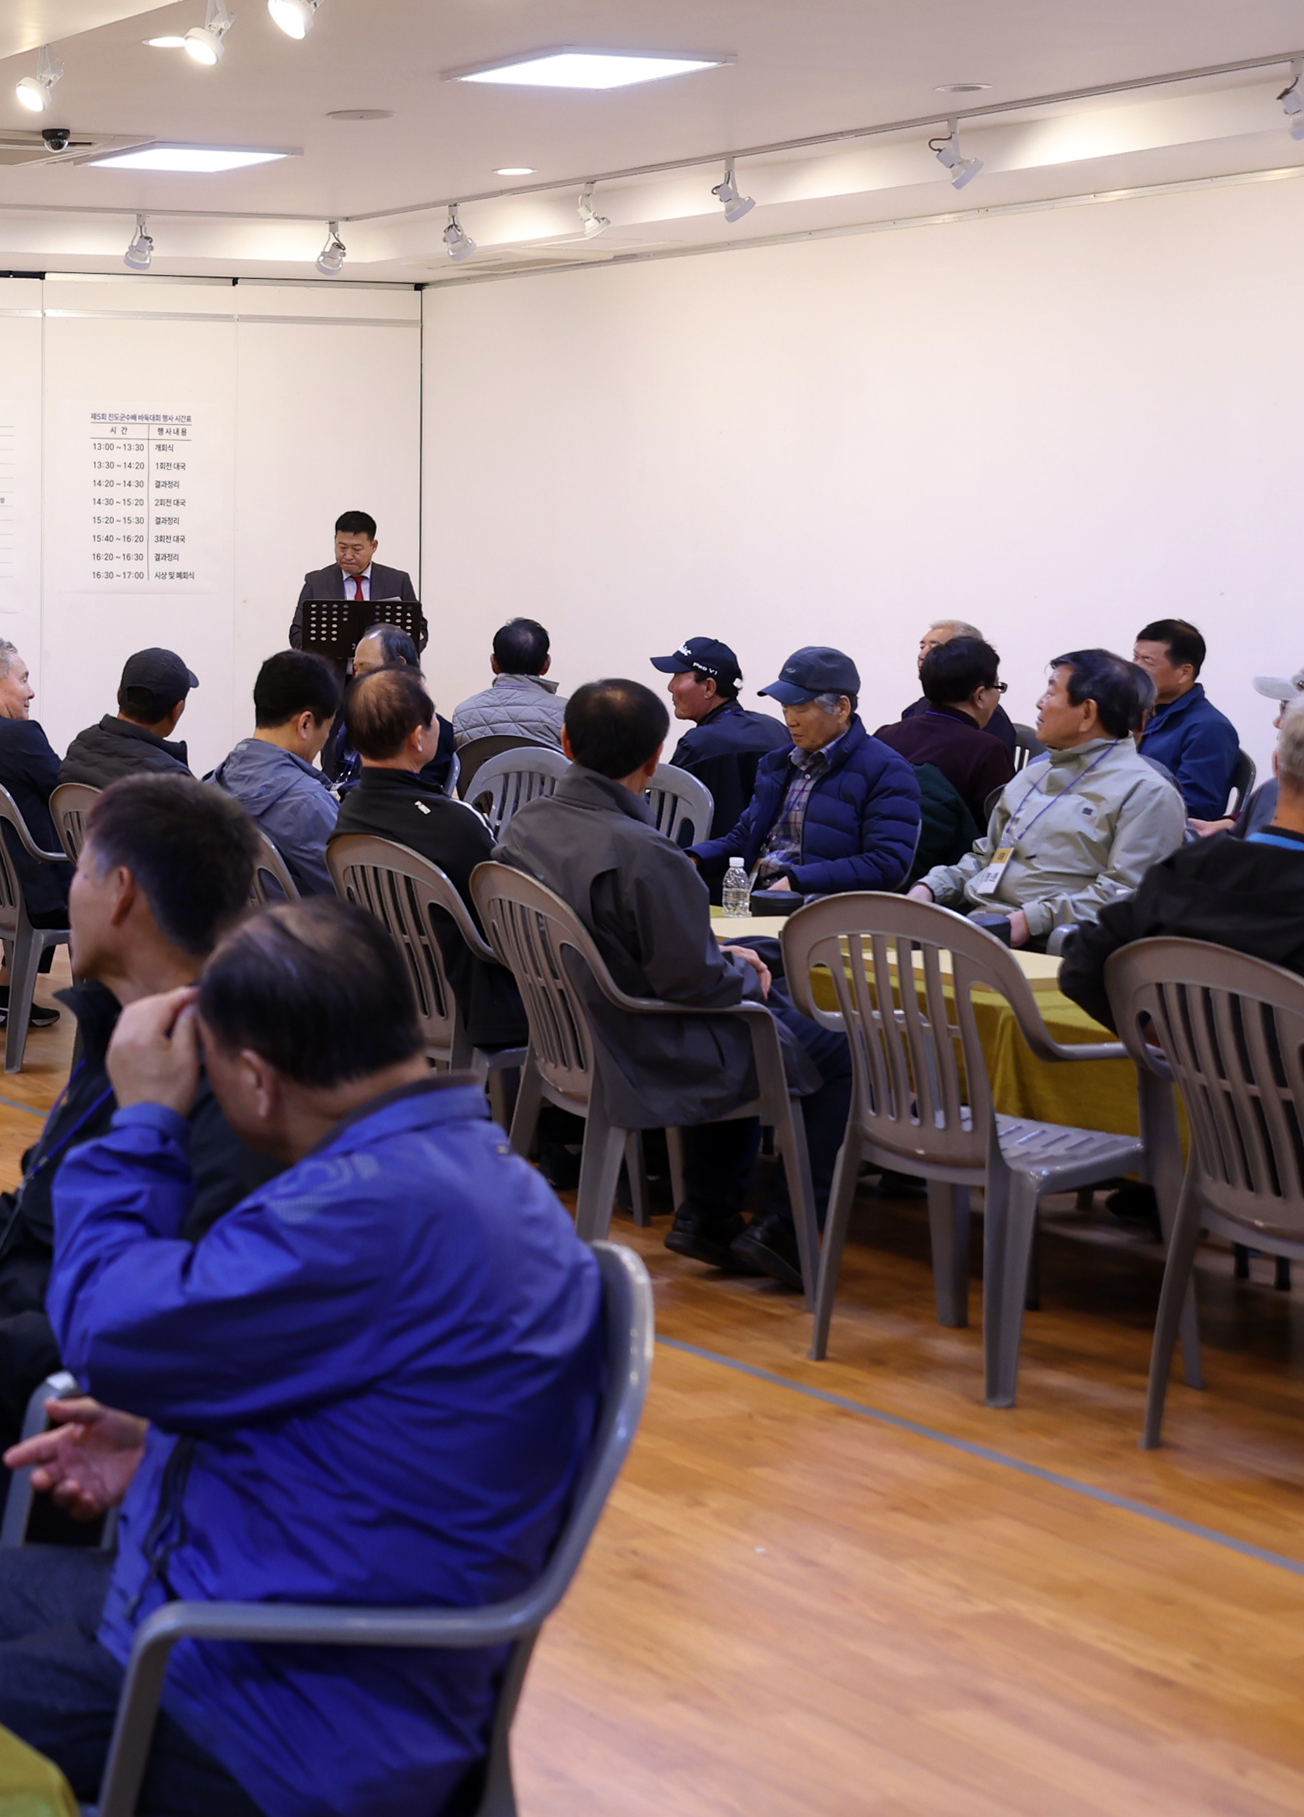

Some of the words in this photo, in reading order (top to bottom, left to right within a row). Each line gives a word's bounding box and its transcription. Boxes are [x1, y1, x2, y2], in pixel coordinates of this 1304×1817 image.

[155, 444, 173, 452] 개회식
[156, 462, 172, 470] 1회전
[155, 480, 179, 488] 결과정리
[155, 499, 171, 507] 2회전
[155, 517, 179, 525] 결과정리
[155, 535, 171, 543] 3회전
[173, 535, 185, 543] 대국
[155, 553, 179, 561] 결과정리
[155, 572, 167, 580] 시상
